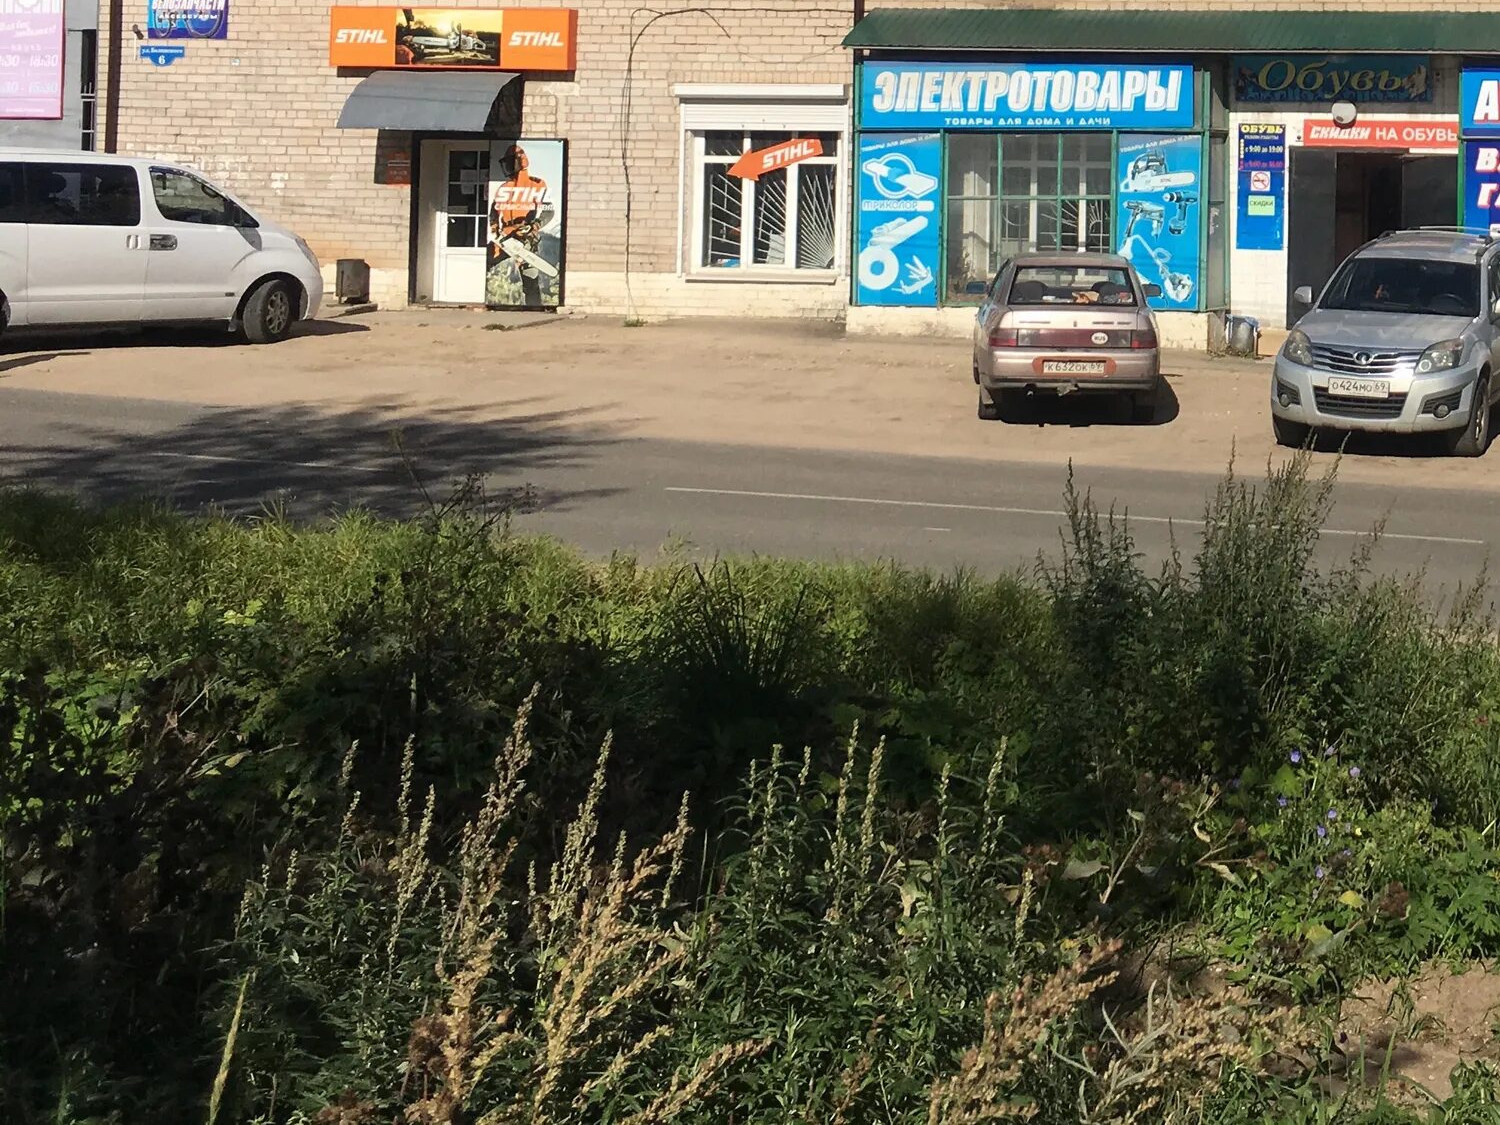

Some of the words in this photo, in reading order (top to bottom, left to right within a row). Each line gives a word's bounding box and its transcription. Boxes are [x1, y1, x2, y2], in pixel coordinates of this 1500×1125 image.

[335, 28, 387, 44] STIHL
[508, 31, 564, 47] STIHL
[158, 55, 166, 64] 6
[1257, 59, 1402, 99] Обувь
[872, 69, 1183, 112] ЭЛЕКТРОТОВАРЫ
[944, 117, 994, 126] ТОВАРЫ
[998, 117, 1022, 126] ДЛЯ
[1027, 118, 1061, 126] ДОМА
[1066, 118, 1075, 126] И
[1080, 118, 1111, 126] ДАЧИ
[1240, 124, 1284, 134] ОБУВЬ
[1309, 126, 1371, 140] СКИДКИ
[1375, 128, 1399, 140] НА
[1402, 128, 1458, 142] ОБУВЬ
[761, 140, 816, 169] STIHL
[494, 186, 552, 203] STIHL
